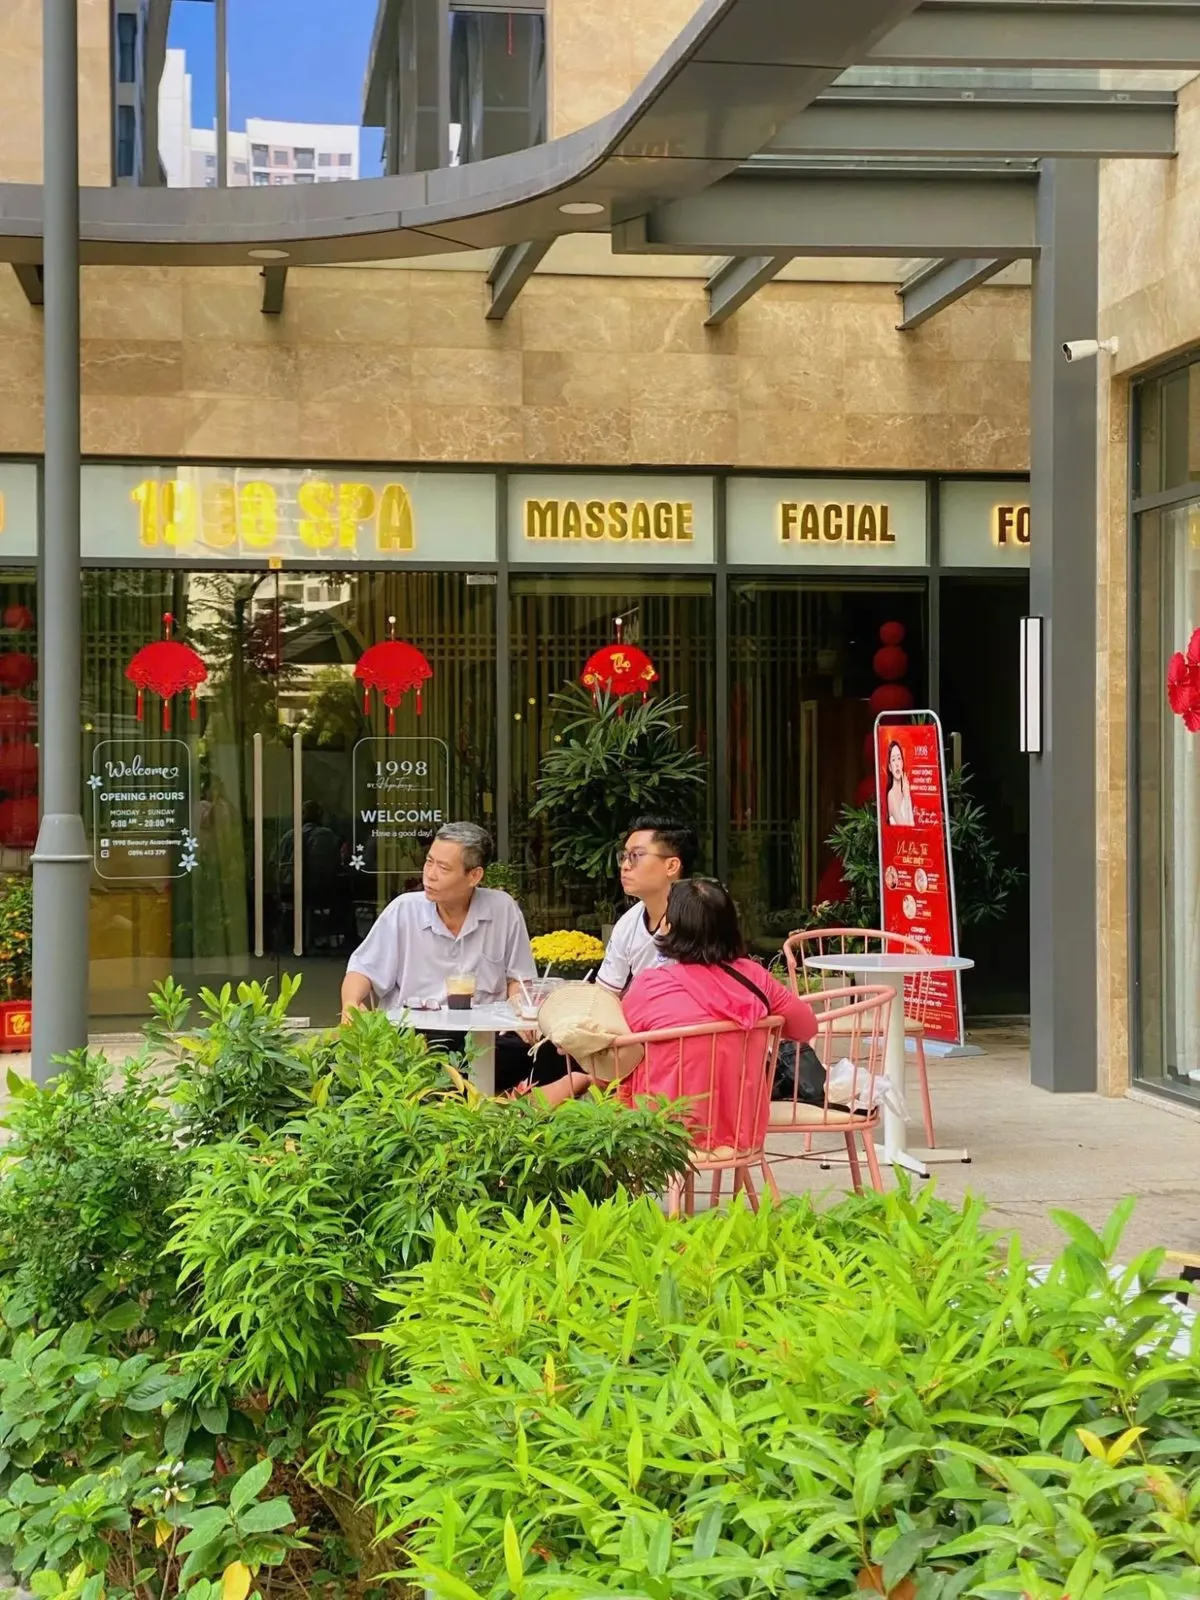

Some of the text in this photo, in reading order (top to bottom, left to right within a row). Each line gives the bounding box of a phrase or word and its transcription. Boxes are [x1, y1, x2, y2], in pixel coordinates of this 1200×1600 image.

[298, 482, 415, 551] SPA
[525, 499, 694, 541] MASSAGE
[780, 502, 896, 543] FACIAL
[105, 754, 179, 779] Welcome
[376, 760, 428, 776] 1998
[100, 792, 185, 801] OPENING HOURS
[361, 809, 442, 823] WELCOME
[371, 829, 391, 837] Have
[398, 829, 417, 839] good
[417, 829, 433, 838] day!
[127, 839, 148, 847] Beauty
